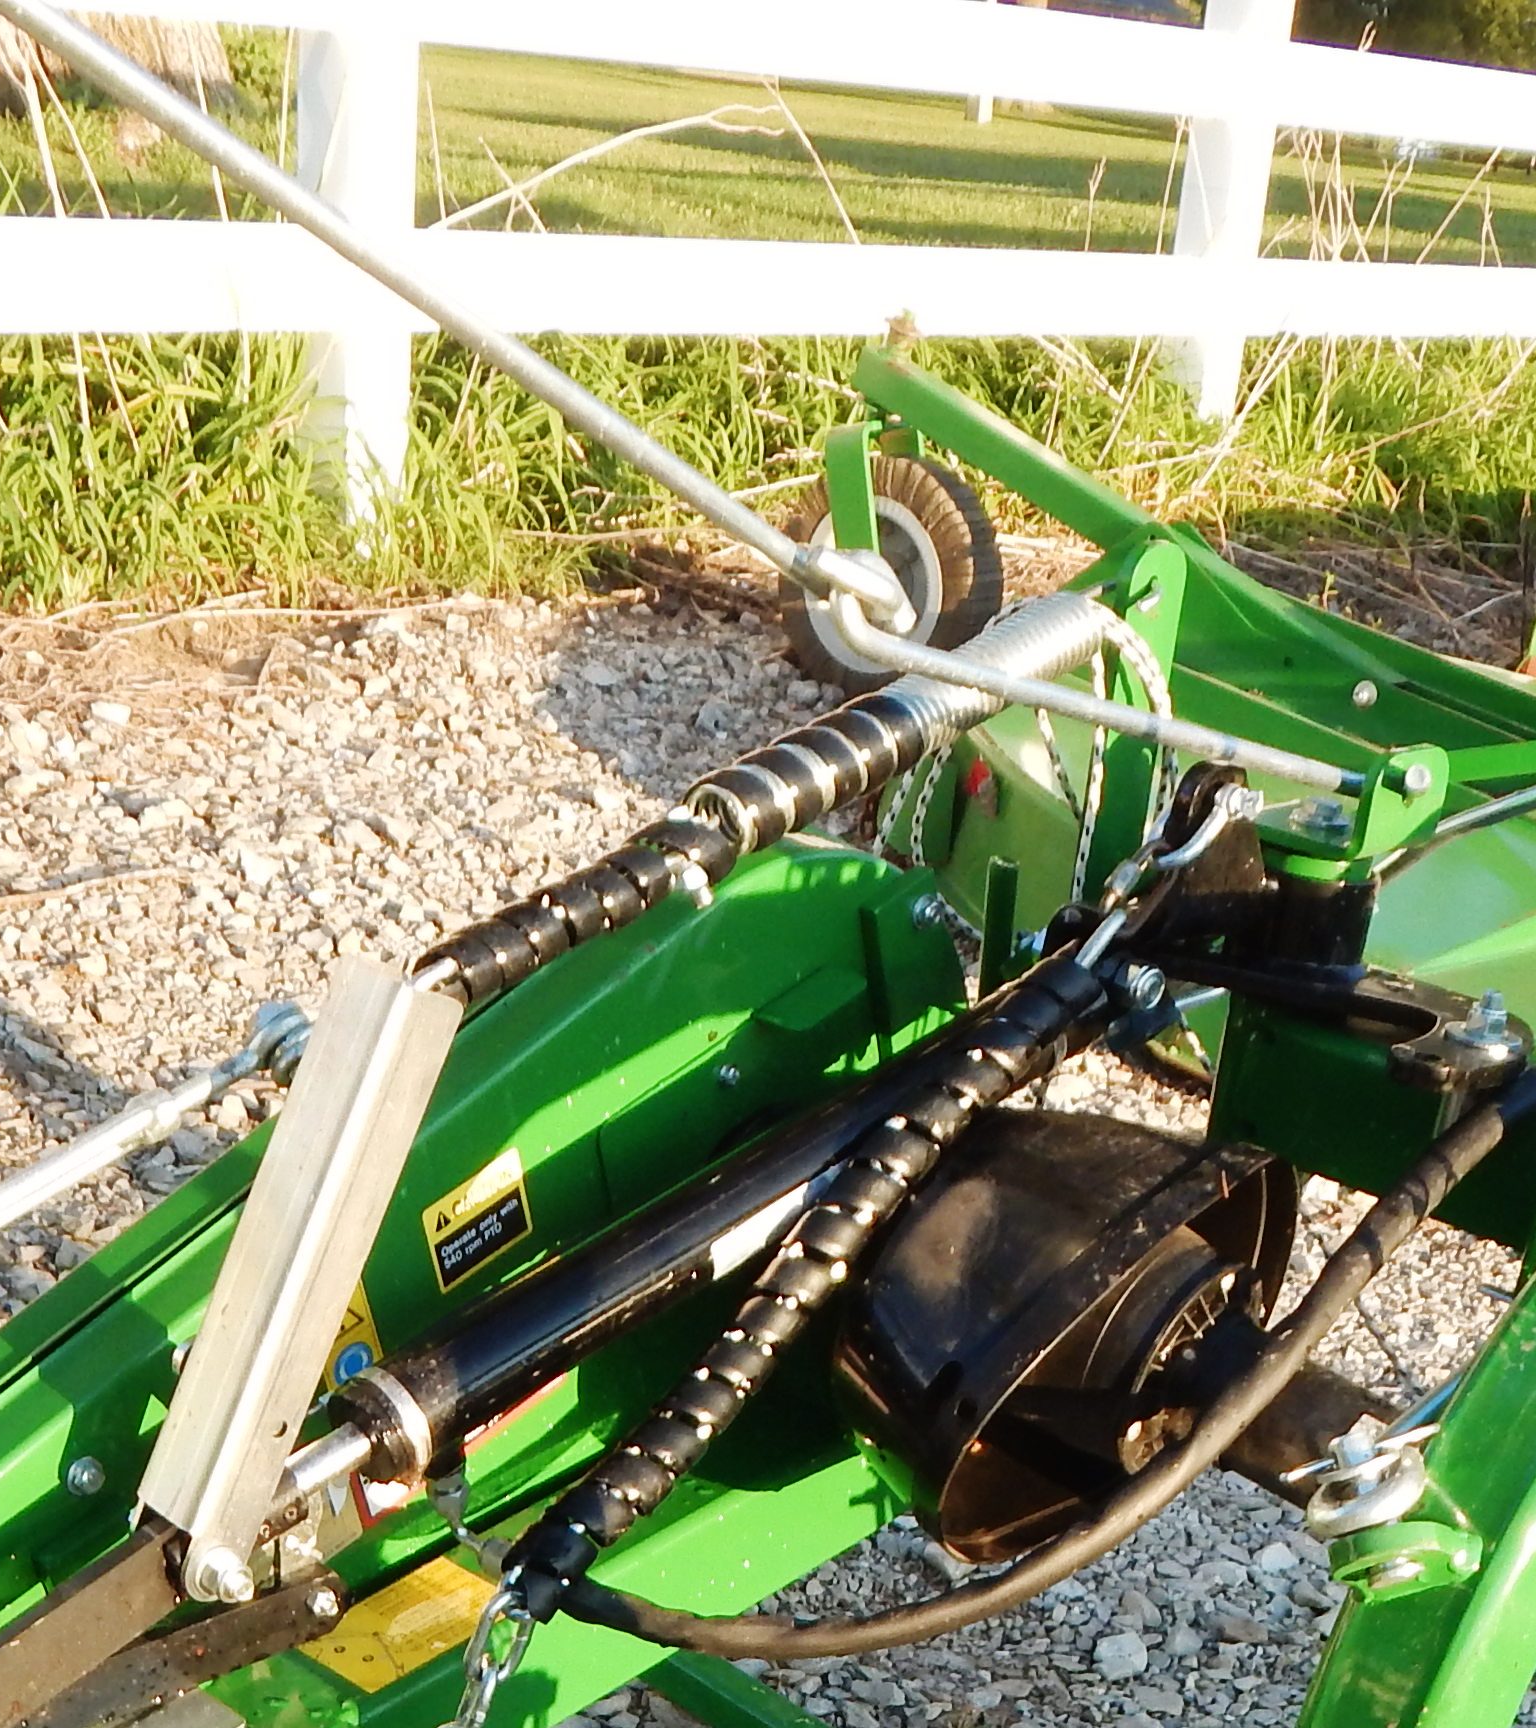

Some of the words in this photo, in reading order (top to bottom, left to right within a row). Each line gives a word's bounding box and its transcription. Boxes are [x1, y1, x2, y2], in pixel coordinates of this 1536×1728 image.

[440, 1227, 477, 1257] Operate
[478, 1212, 497, 1231] only
[499, 1198, 518, 1216] with
[444, 1249, 462, 1269] 540
[464, 1237, 482, 1255] rpm
[483, 1220, 502, 1240] PTO
